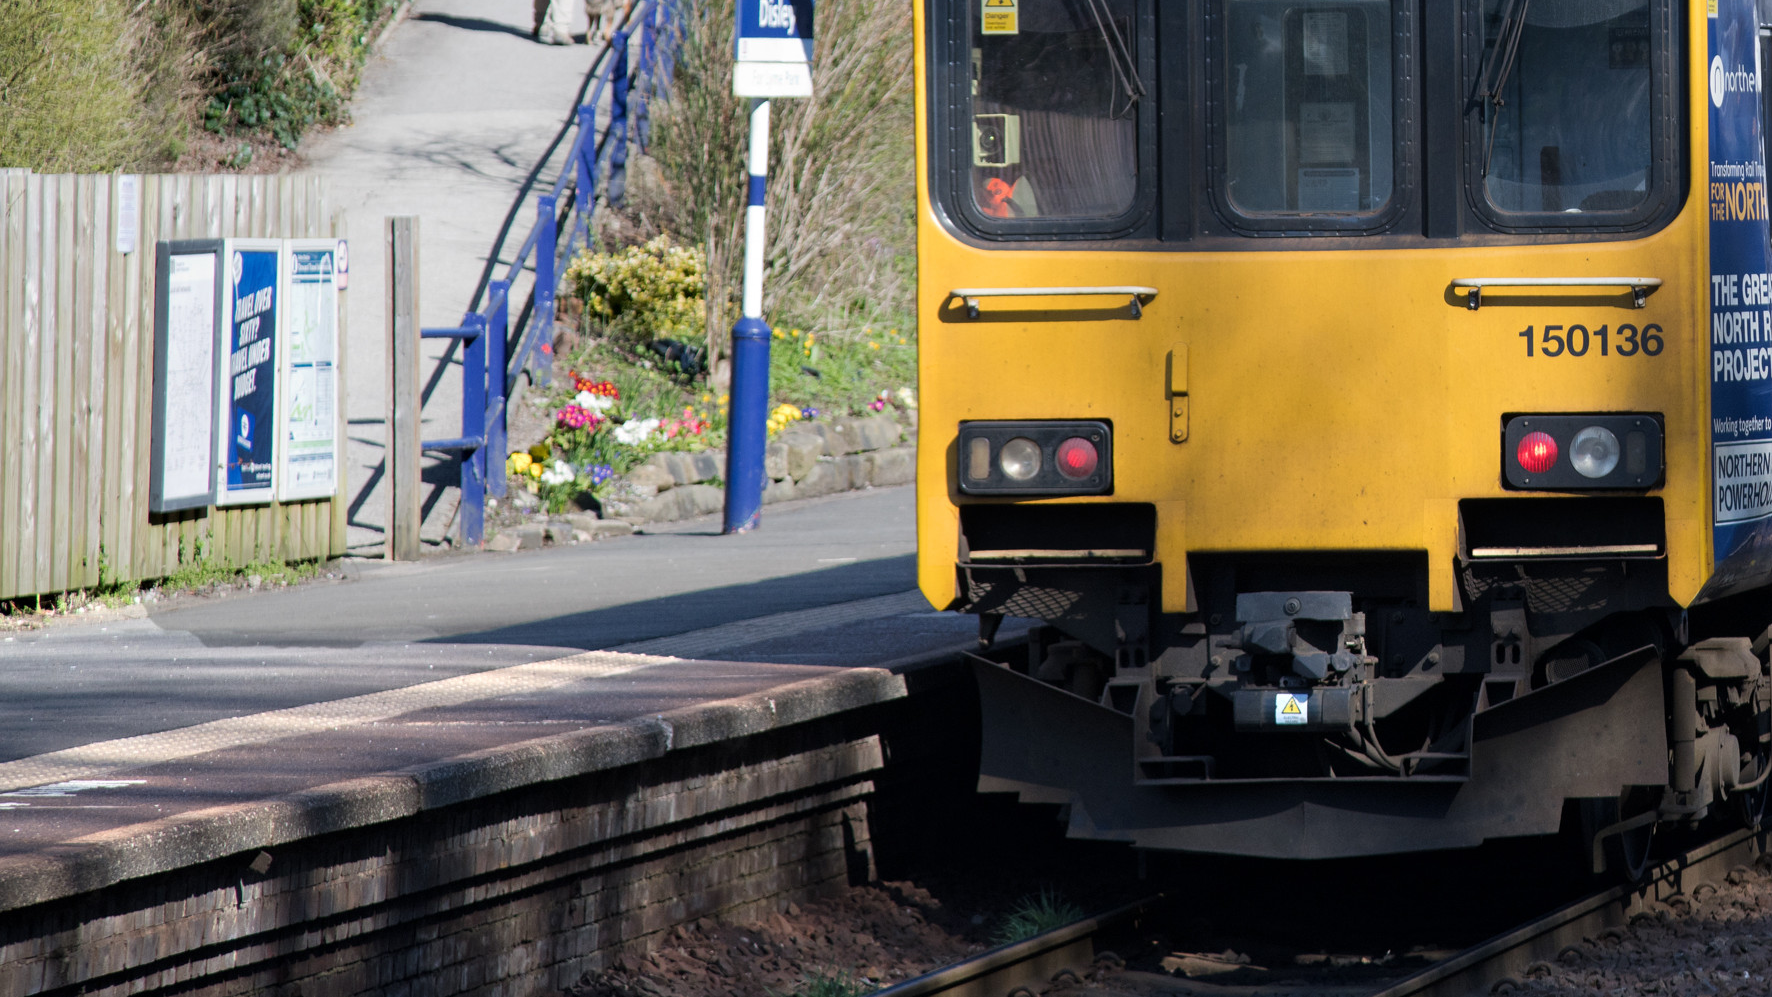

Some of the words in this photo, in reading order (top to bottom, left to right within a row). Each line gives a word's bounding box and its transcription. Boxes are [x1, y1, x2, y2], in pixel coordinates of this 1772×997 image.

[1710, 160, 1745, 181] Transforming
[1745, 160, 1755, 177] Rail
[1711, 182, 1724, 201] FOR
[1725, 182, 1768, 221] NORTH
[1711, 203, 1725, 221] THE
[235, 292, 255, 323] TRAVEL
[254, 286, 272, 314] OVER
[1712, 275, 1738, 306] THE
[1518, 323, 1665, 358] 150136
[1714, 311, 1759, 345] NORTH
[248, 337, 271, 368] UNDER
[1714, 416, 1738, 437] Working
[1739, 414, 1764, 436] together
[1765, 416, 1771, 430] to
[1718, 452, 1771, 479] NORTHERN
